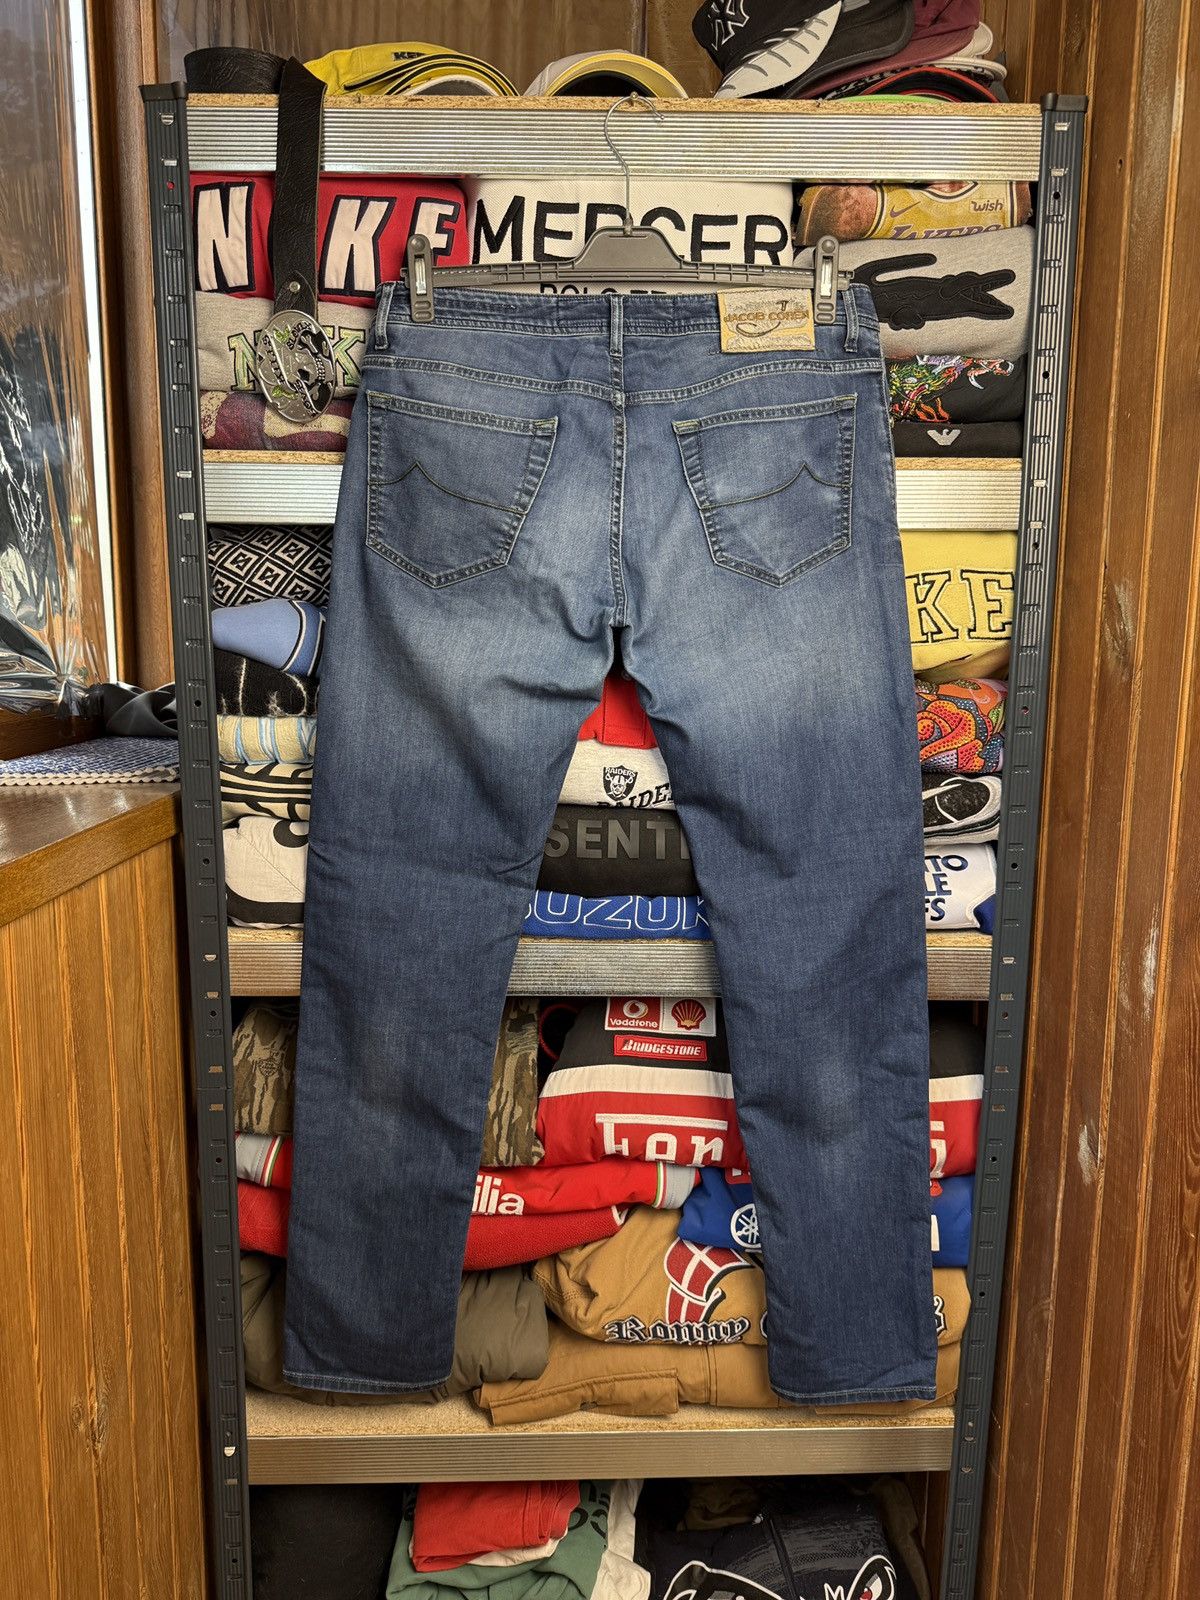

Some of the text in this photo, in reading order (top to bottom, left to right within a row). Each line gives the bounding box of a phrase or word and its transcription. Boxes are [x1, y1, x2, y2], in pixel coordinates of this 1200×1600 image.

[971, 200, 1003, 213] wish
[193, 182, 461, 296] NKE
[604, 767, 636, 778] RAIDERS
[924, 854, 969, 872] TO
[603, 1314, 751, 1345] Ronny
